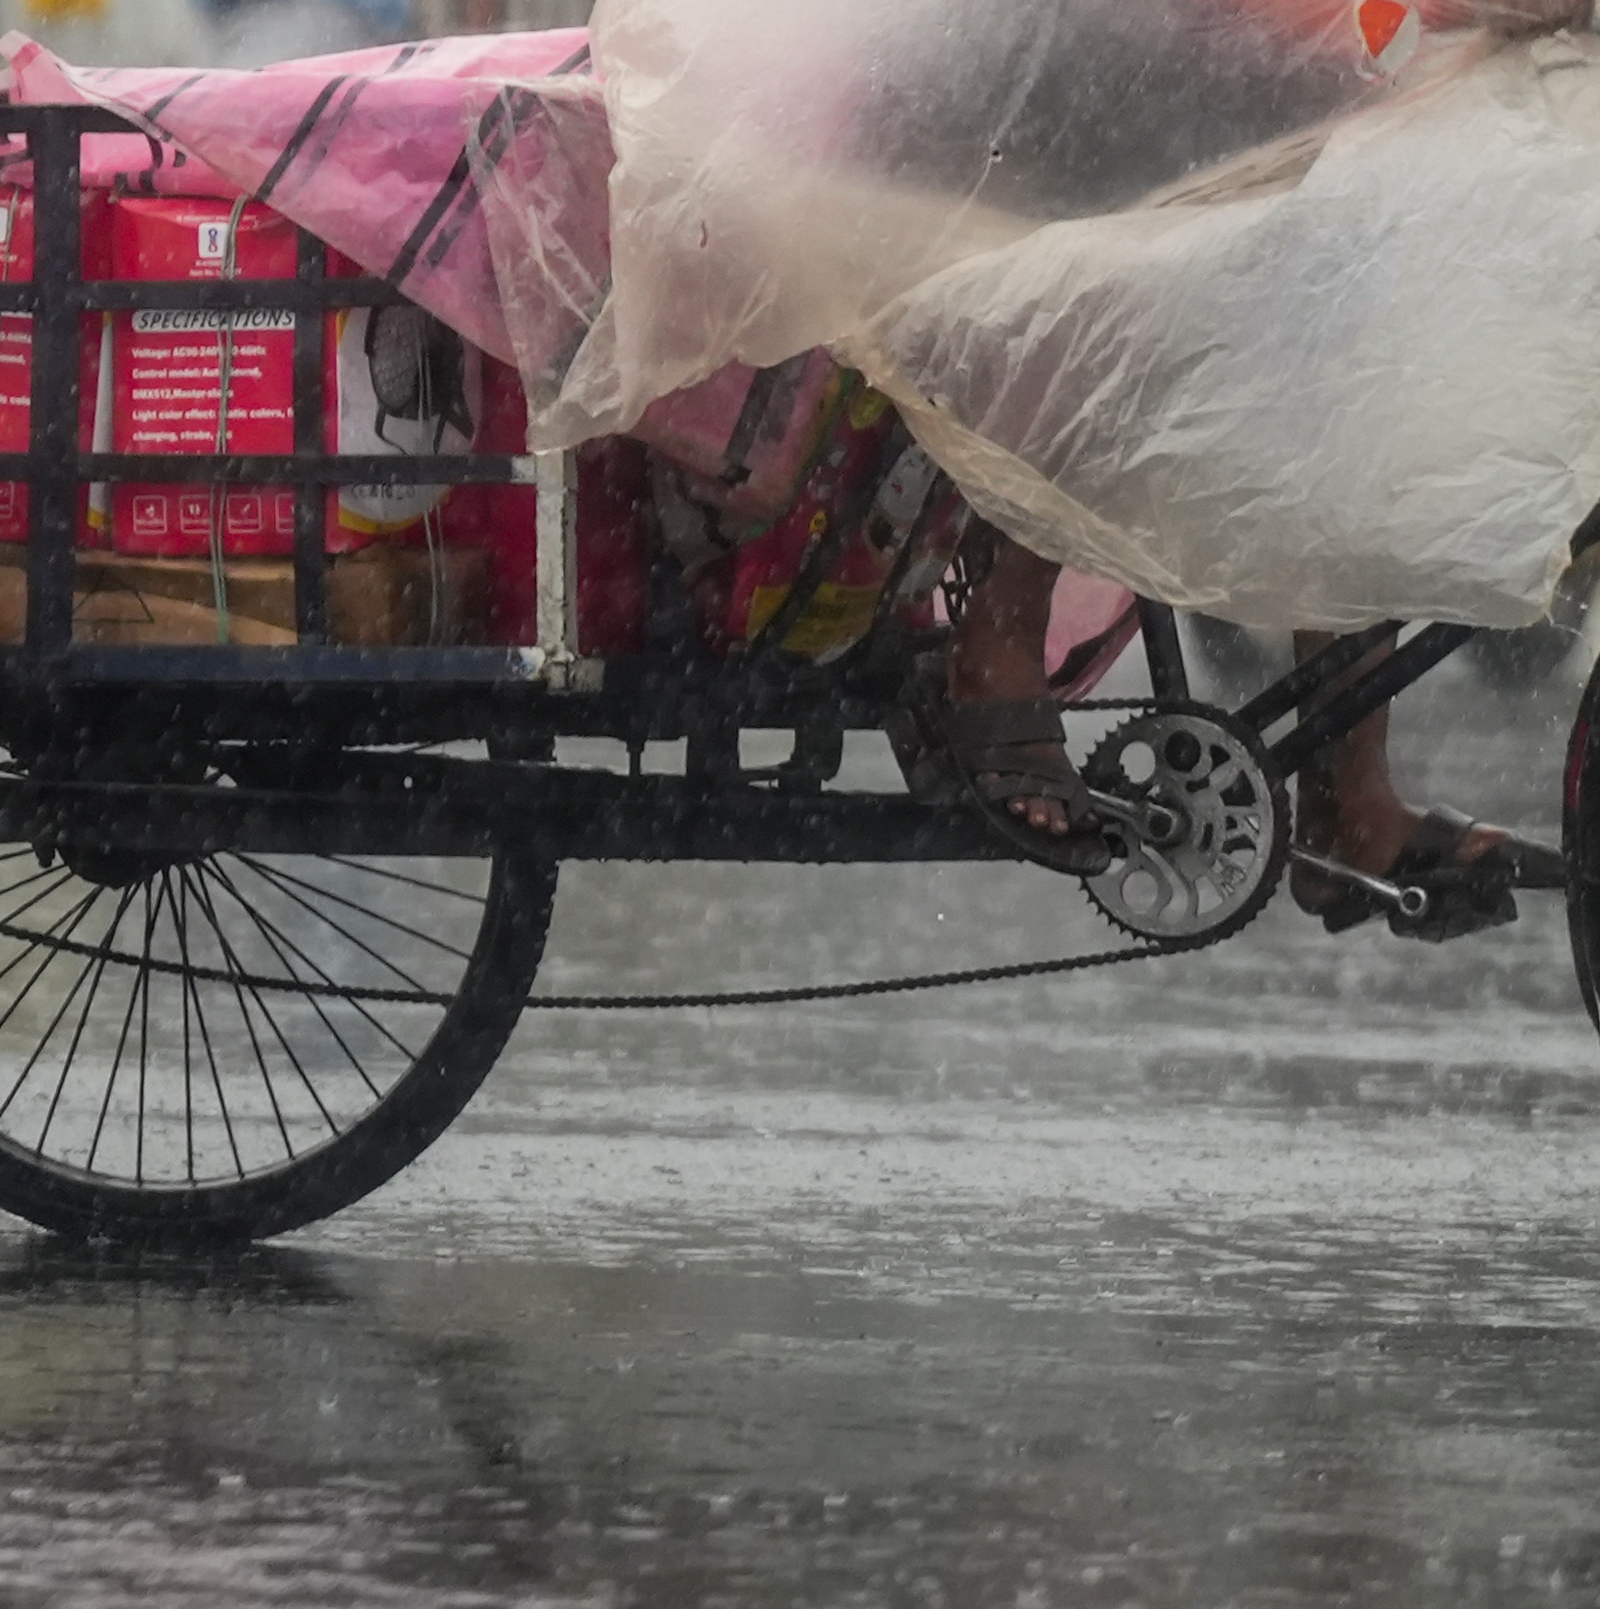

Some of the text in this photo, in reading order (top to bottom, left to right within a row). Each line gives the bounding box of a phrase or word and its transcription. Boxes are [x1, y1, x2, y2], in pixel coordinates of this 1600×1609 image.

[132, 368, 168, 380] Control
[132, 410, 157, 423] Light
[158, 411, 183, 421] color
